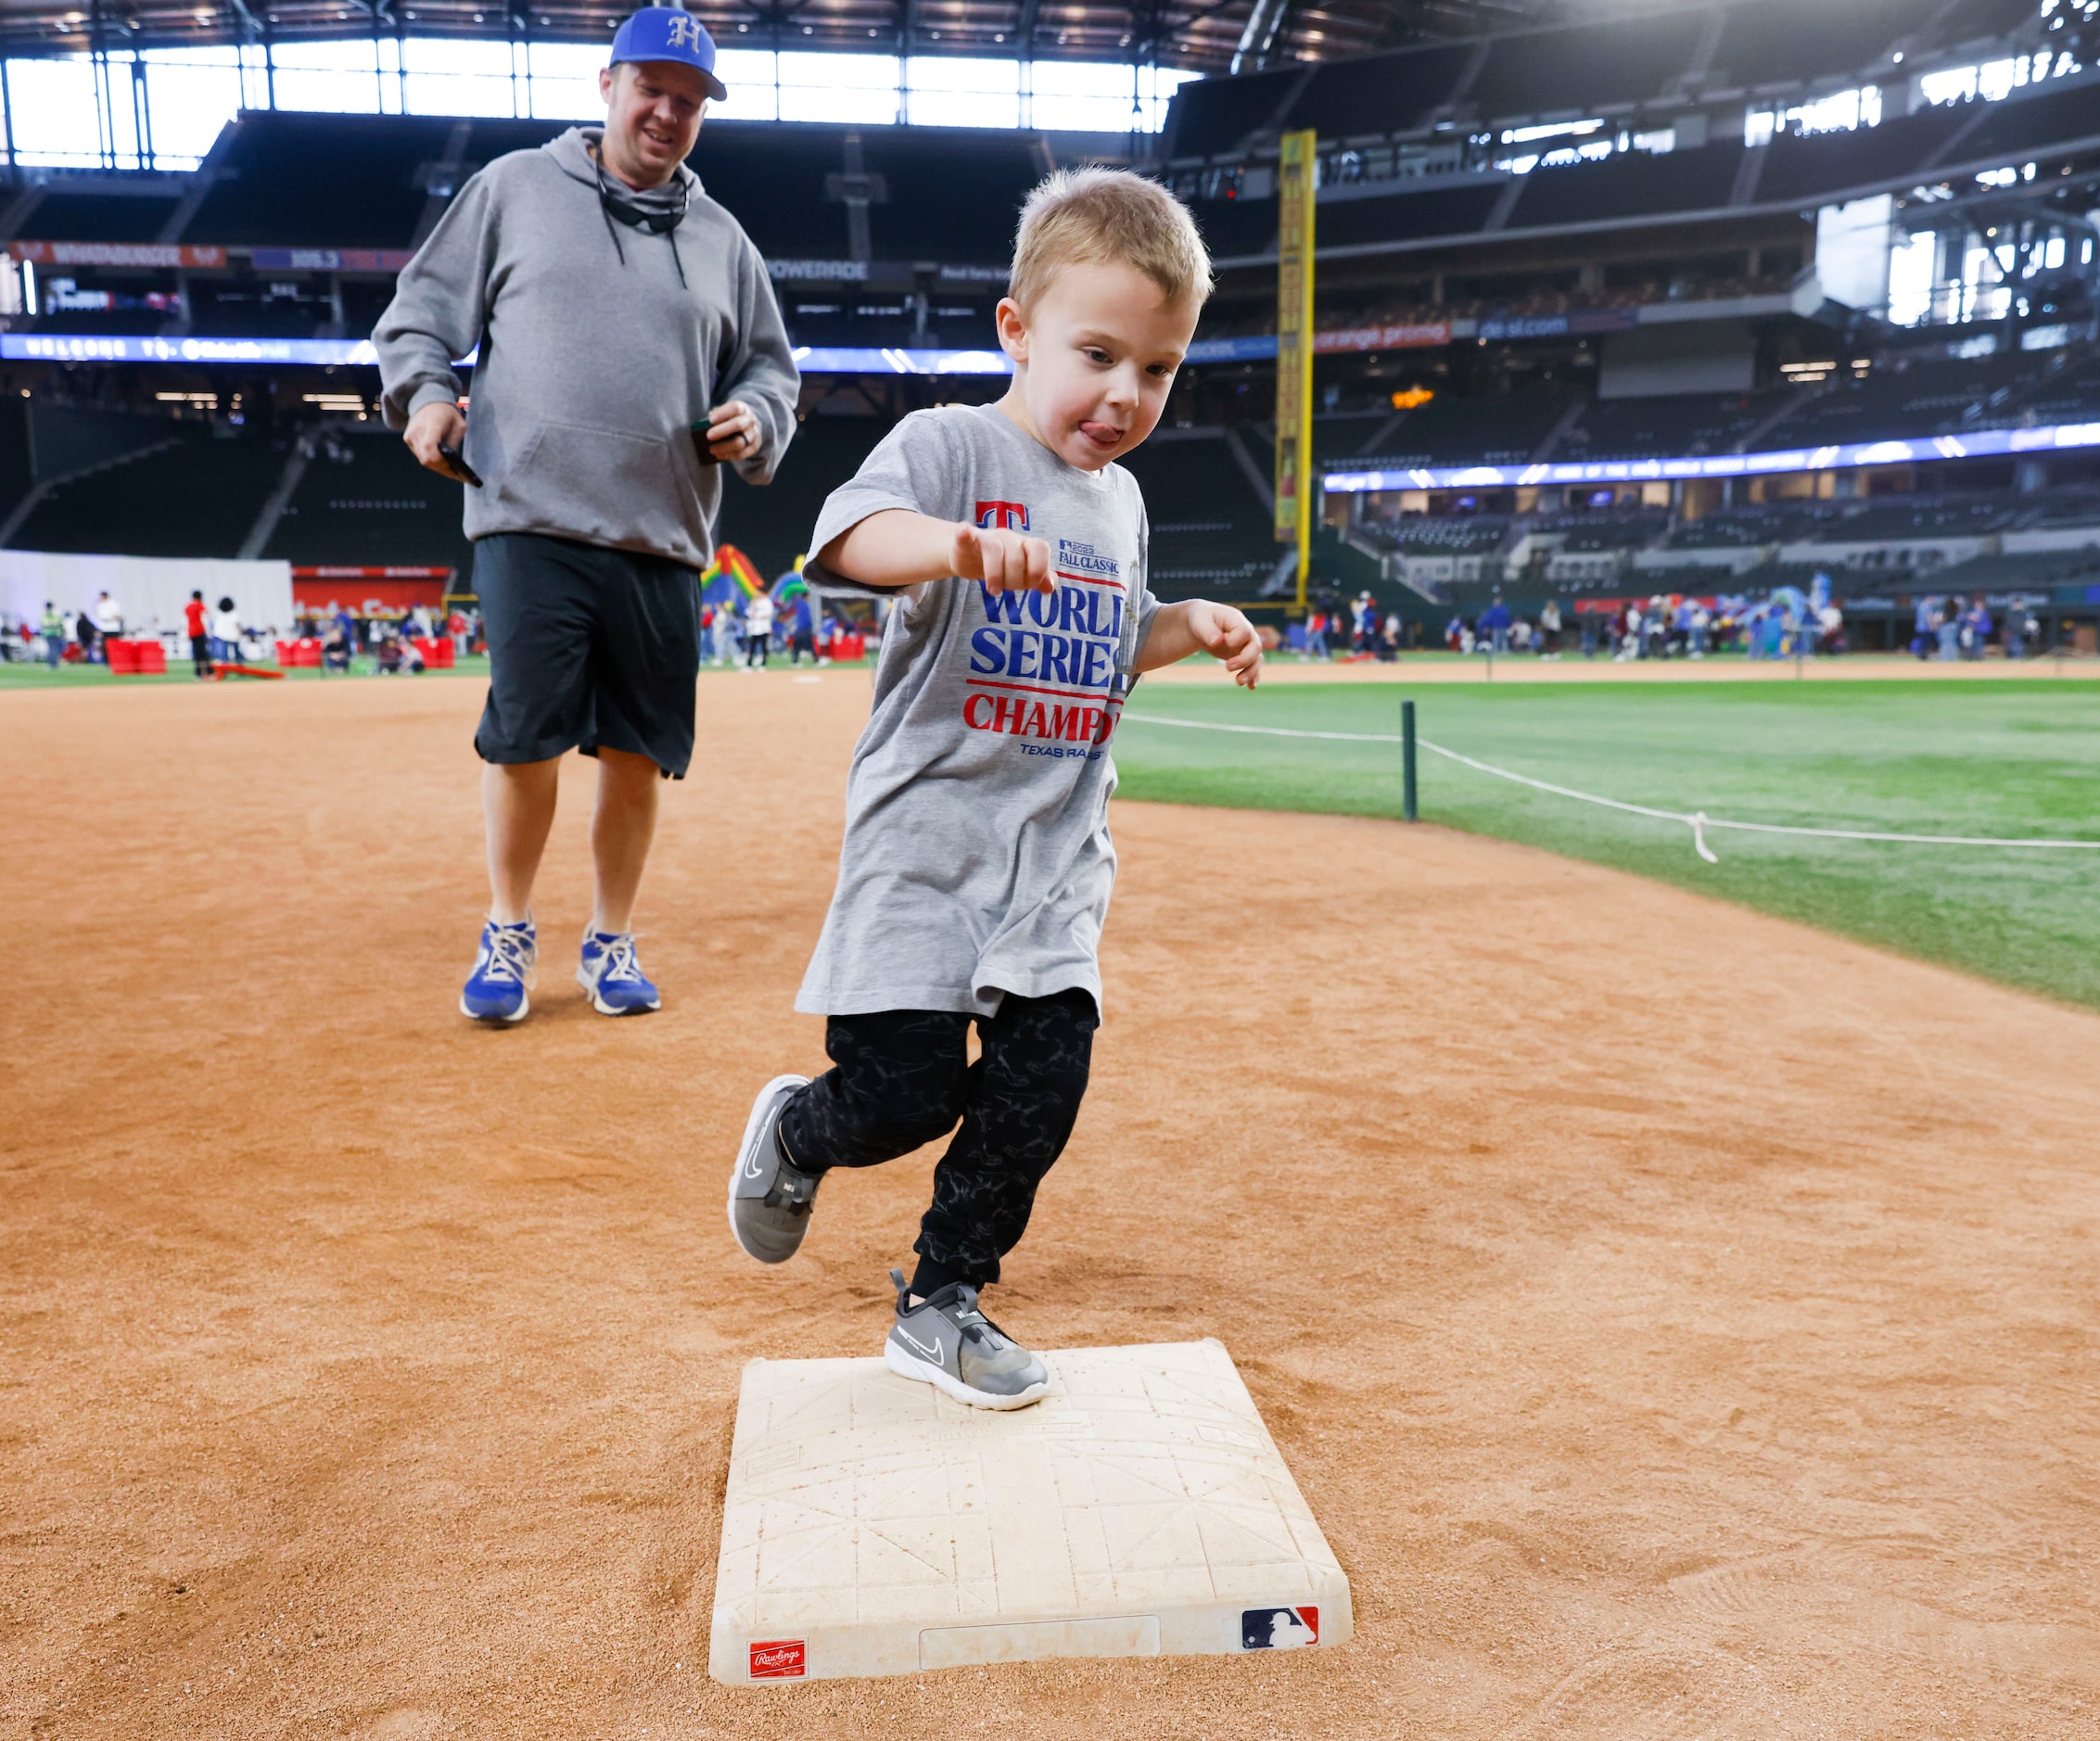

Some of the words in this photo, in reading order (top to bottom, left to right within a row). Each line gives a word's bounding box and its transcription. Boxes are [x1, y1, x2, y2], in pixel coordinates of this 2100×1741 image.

[1072, 543, 1094, 555] 2023
[1059, 551, 1080, 566] FALL
[1080, 556, 1120, 574] CLASSIC
[970, 627, 1126, 690] SERIE
[1020, 743, 1064, 758] TEXAS
[755, 1649, 800, 1666] Rawlings
